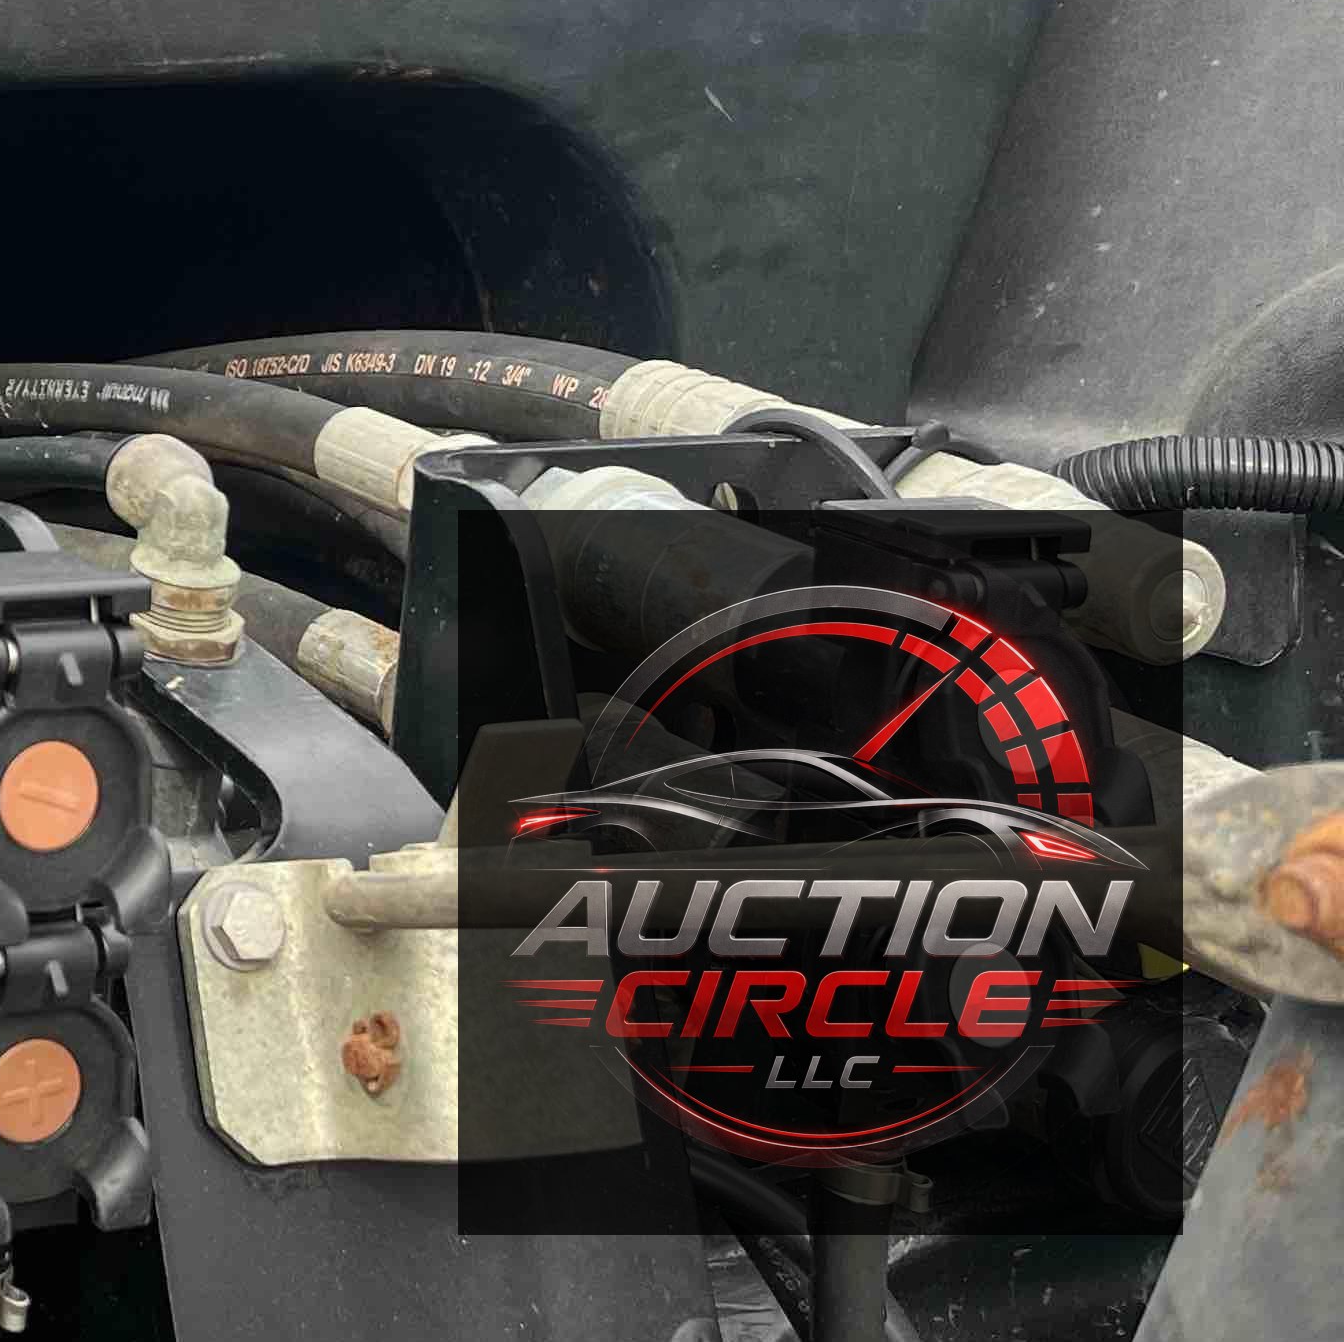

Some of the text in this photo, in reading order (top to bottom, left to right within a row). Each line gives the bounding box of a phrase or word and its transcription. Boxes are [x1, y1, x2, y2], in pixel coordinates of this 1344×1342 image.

[225, 358, 248, 378] ISO
[320, 352, 342, 373] JIS
[413, 354, 436, 375] DN
[439, 356, 457, 377] 19
[551, 373, 579, 399] WP
